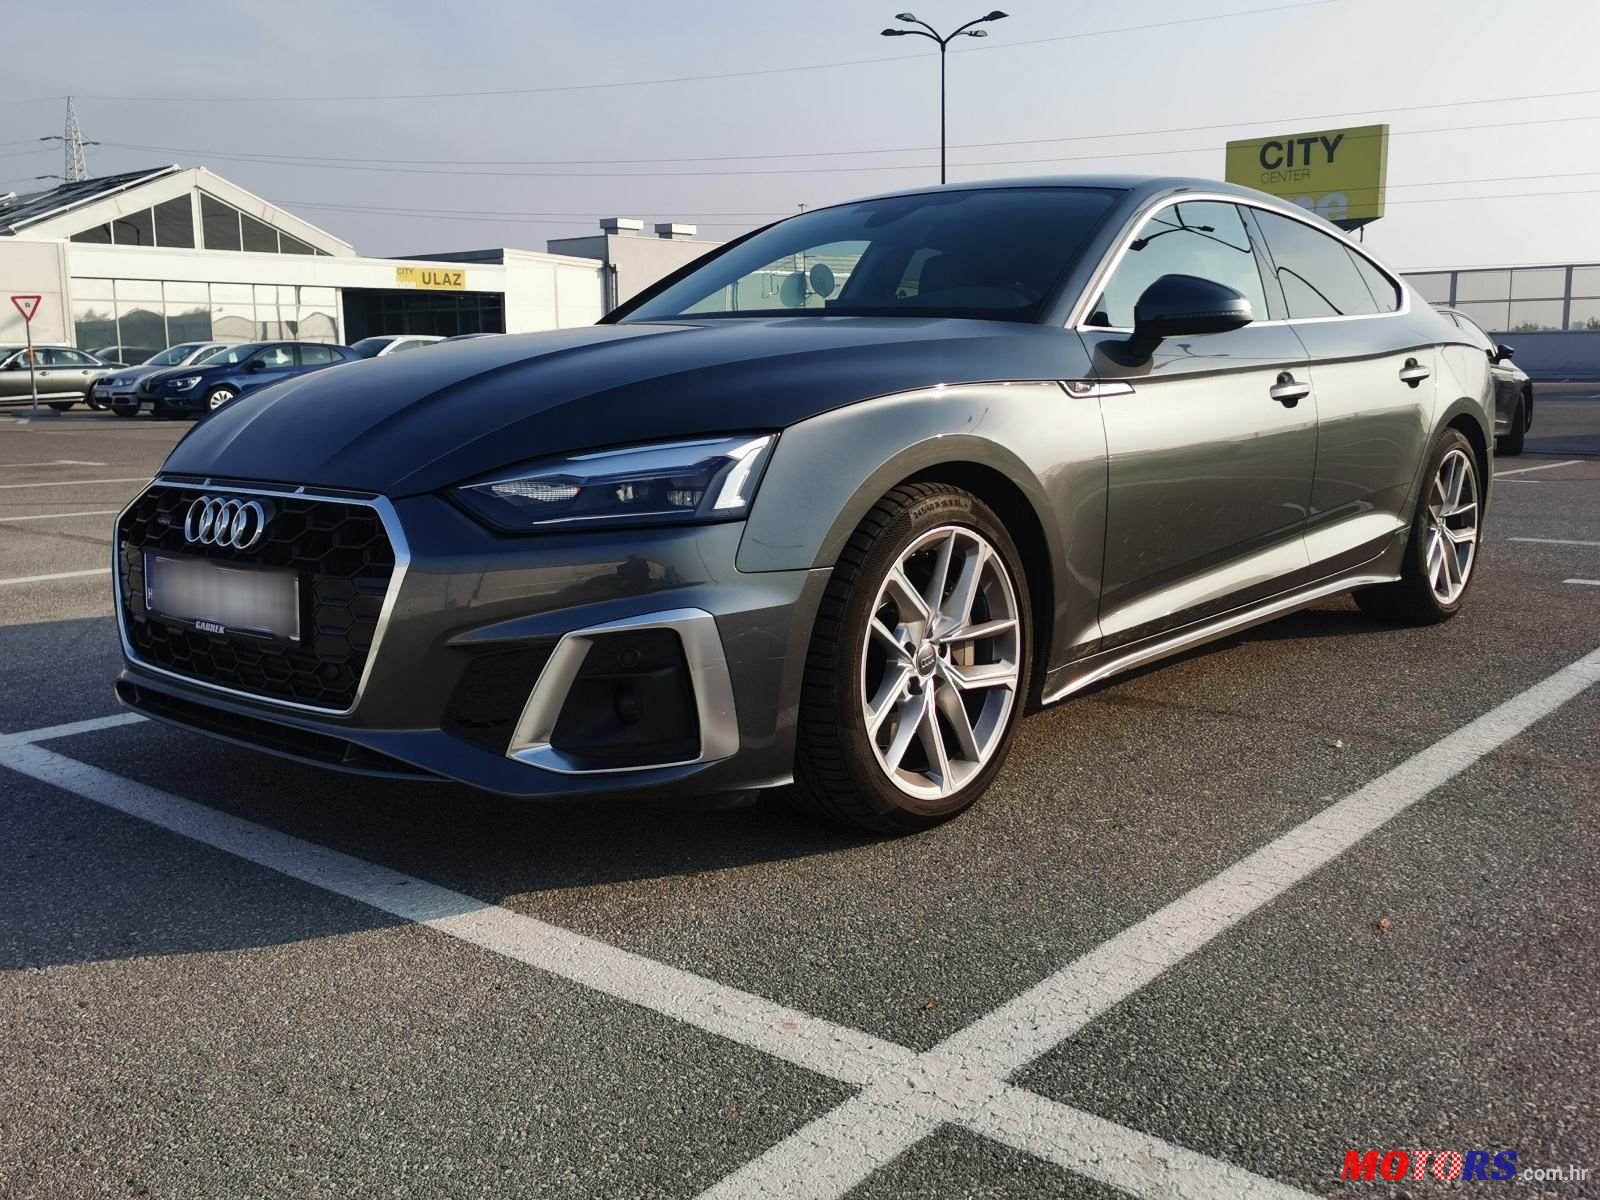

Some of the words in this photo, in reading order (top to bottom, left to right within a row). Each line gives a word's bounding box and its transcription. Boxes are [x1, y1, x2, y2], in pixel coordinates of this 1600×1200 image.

[1260, 134, 1344, 169] CITY
[1260, 168, 1310, 184] CENTER
[397, 267, 414, 275] CITY
[422, 271, 462, 286] ULAZ
